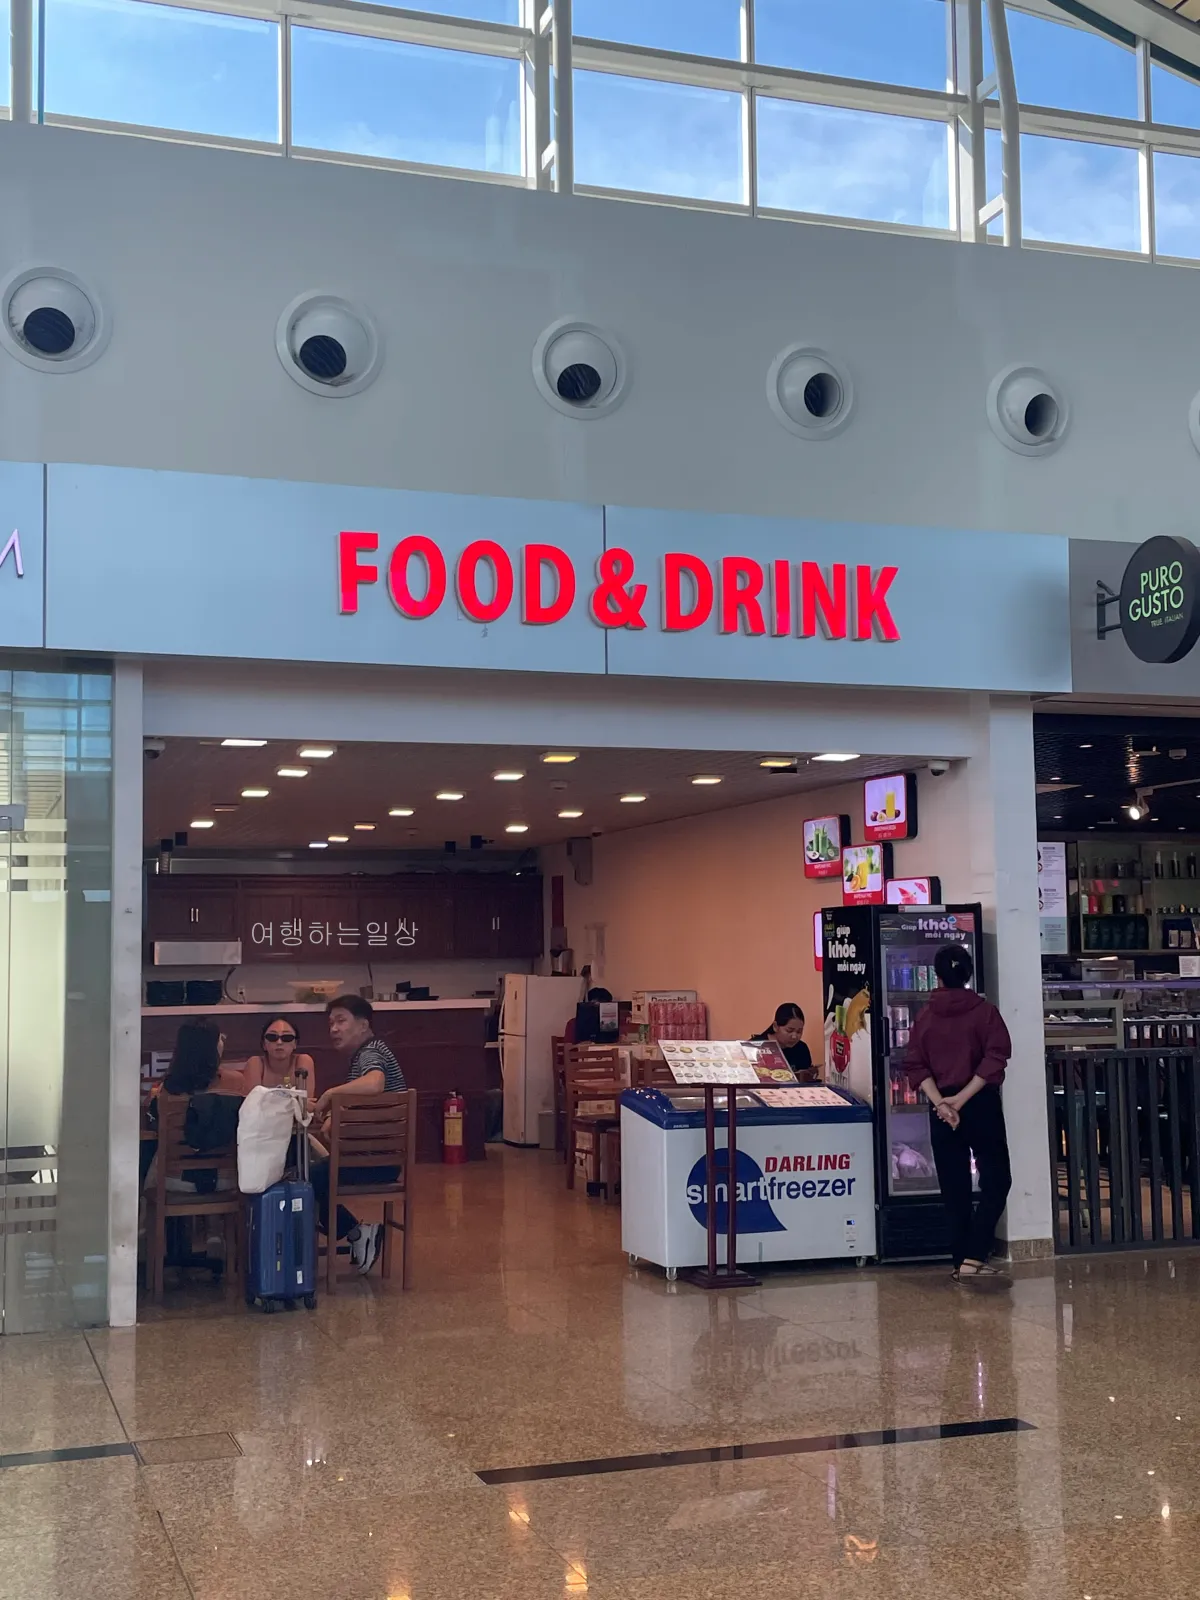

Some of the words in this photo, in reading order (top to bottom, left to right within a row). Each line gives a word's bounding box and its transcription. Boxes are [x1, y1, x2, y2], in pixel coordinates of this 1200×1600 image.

[337, 531, 576, 625] FOOD
[589, 547, 648, 629] &
[660, 552, 901, 642] DRINK
[1140, 560, 1183, 594] PURO
[1128, 585, 1184, 621] GUSTO
[764, 1153, 851, 1173] DARLING
